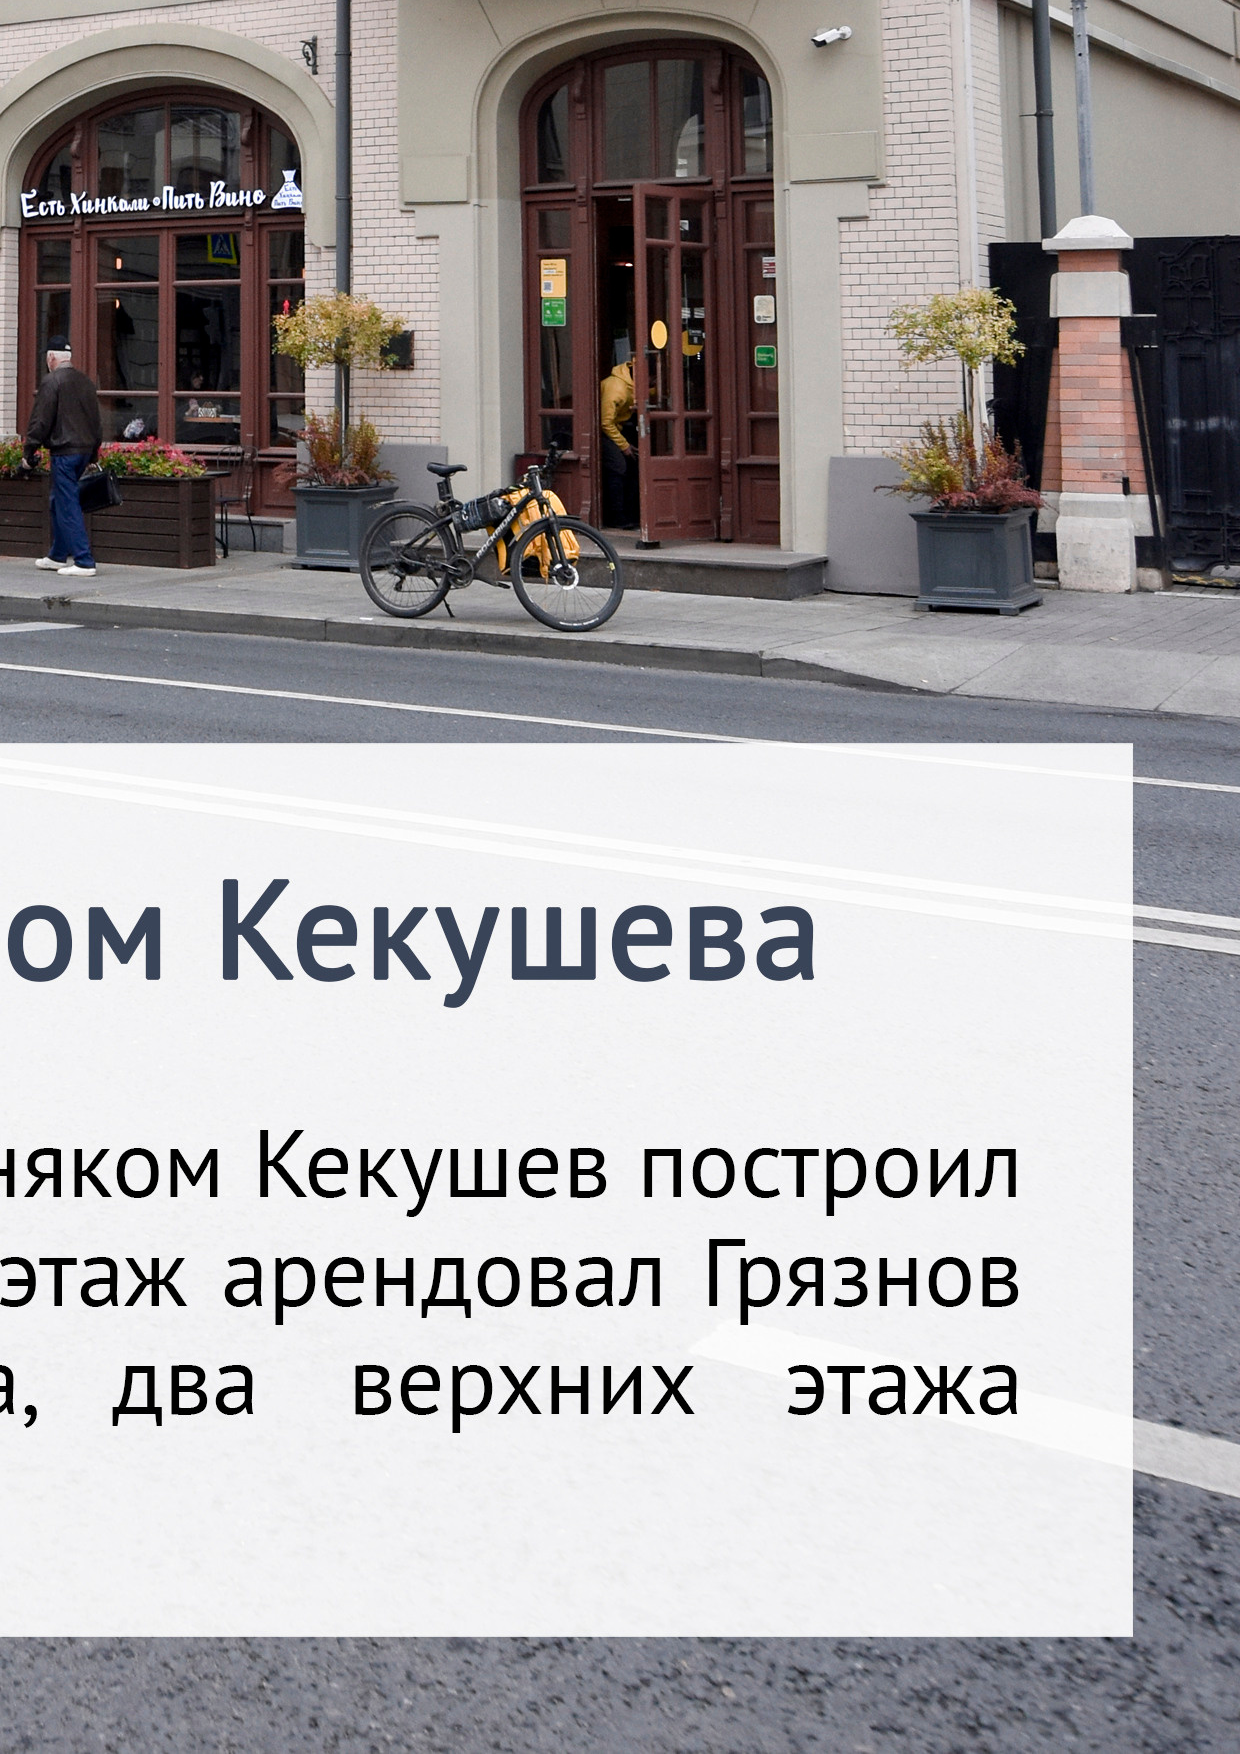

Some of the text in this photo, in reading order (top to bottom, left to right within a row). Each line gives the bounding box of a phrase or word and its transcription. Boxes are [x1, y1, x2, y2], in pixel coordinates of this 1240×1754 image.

[21, 180, 266, 218] Есть Хинкали Пить Вино
[476, 507, 517, 559] ROCKRIDER
